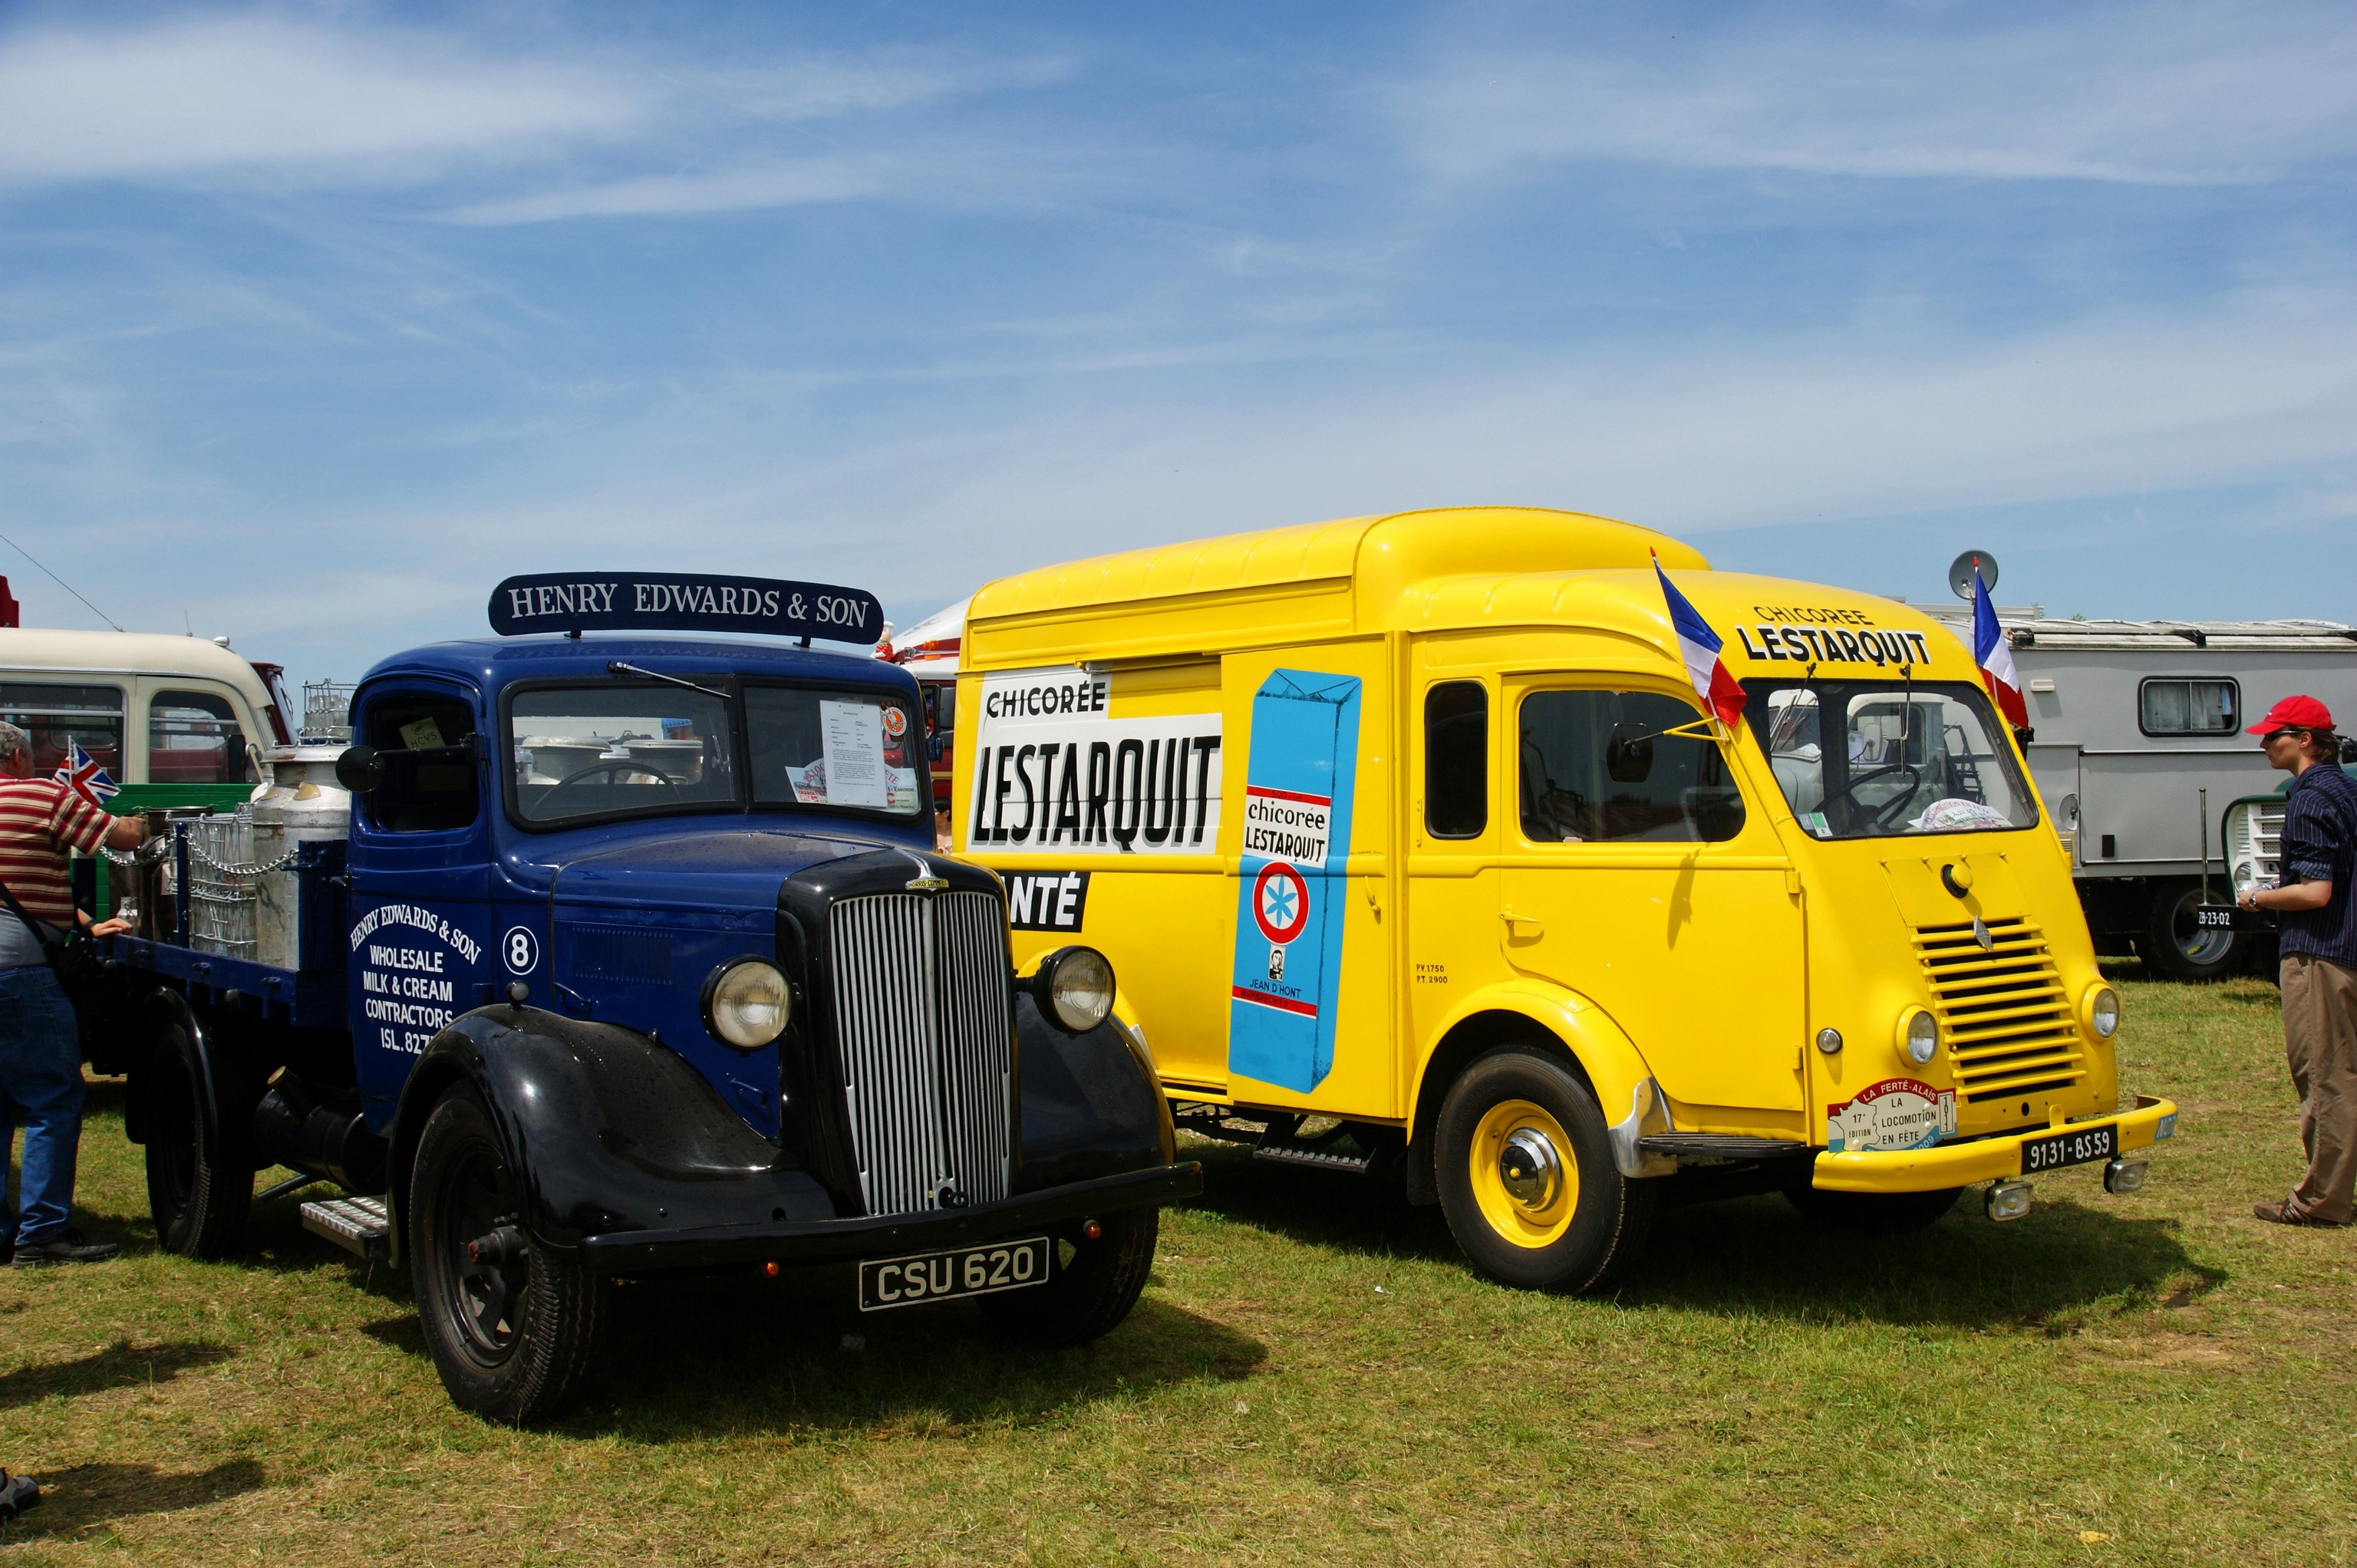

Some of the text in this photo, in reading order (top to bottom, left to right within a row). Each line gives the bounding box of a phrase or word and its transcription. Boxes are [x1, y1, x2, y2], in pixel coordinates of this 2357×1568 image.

[508, 583, 618, 618] HENRY
[633, 583, 780, 616] EDWARDS
[787, 593, 808, 621] &
[816, 595, 869, 628] SON
[1753, 606, 1874, 625] CHICOREE
[1736, 626, 1930, 667] LESTARQUIT
[987, 680, 1106, 719] CHICORÉE
[973, 735, 1222, 852] LESTARQUIT
[1248, 798, 1325, 830] chicorée
[1245, 826, 1325, 863] LESTARQUIT
[351, 904, 482, 965] HENRY EDWARDS & SON
[369, 944, 443, 973] WHOLESALE
[511, 934, 529, 967] 8
[363, 970, 453, 1002] MILK & CREAM
[1240, 989, 1289, 1008] WAMBRECHIES
[1249, 978, 1270, 992] JEAN
[365, 998, 453, 1029] CONTRACTORS
[1862, 1089, 1876, 1102] LA
[1891, 1098, 1903, 1108] LA
[1848, 1128, 1871, 1138] EDITION
[1881, 1109, 1937, 1128] LOCOMOTION
[1882, 1130, 1919, 1145] EN FÊTE
[879, 1246, 1033, 1301] CSU 620
